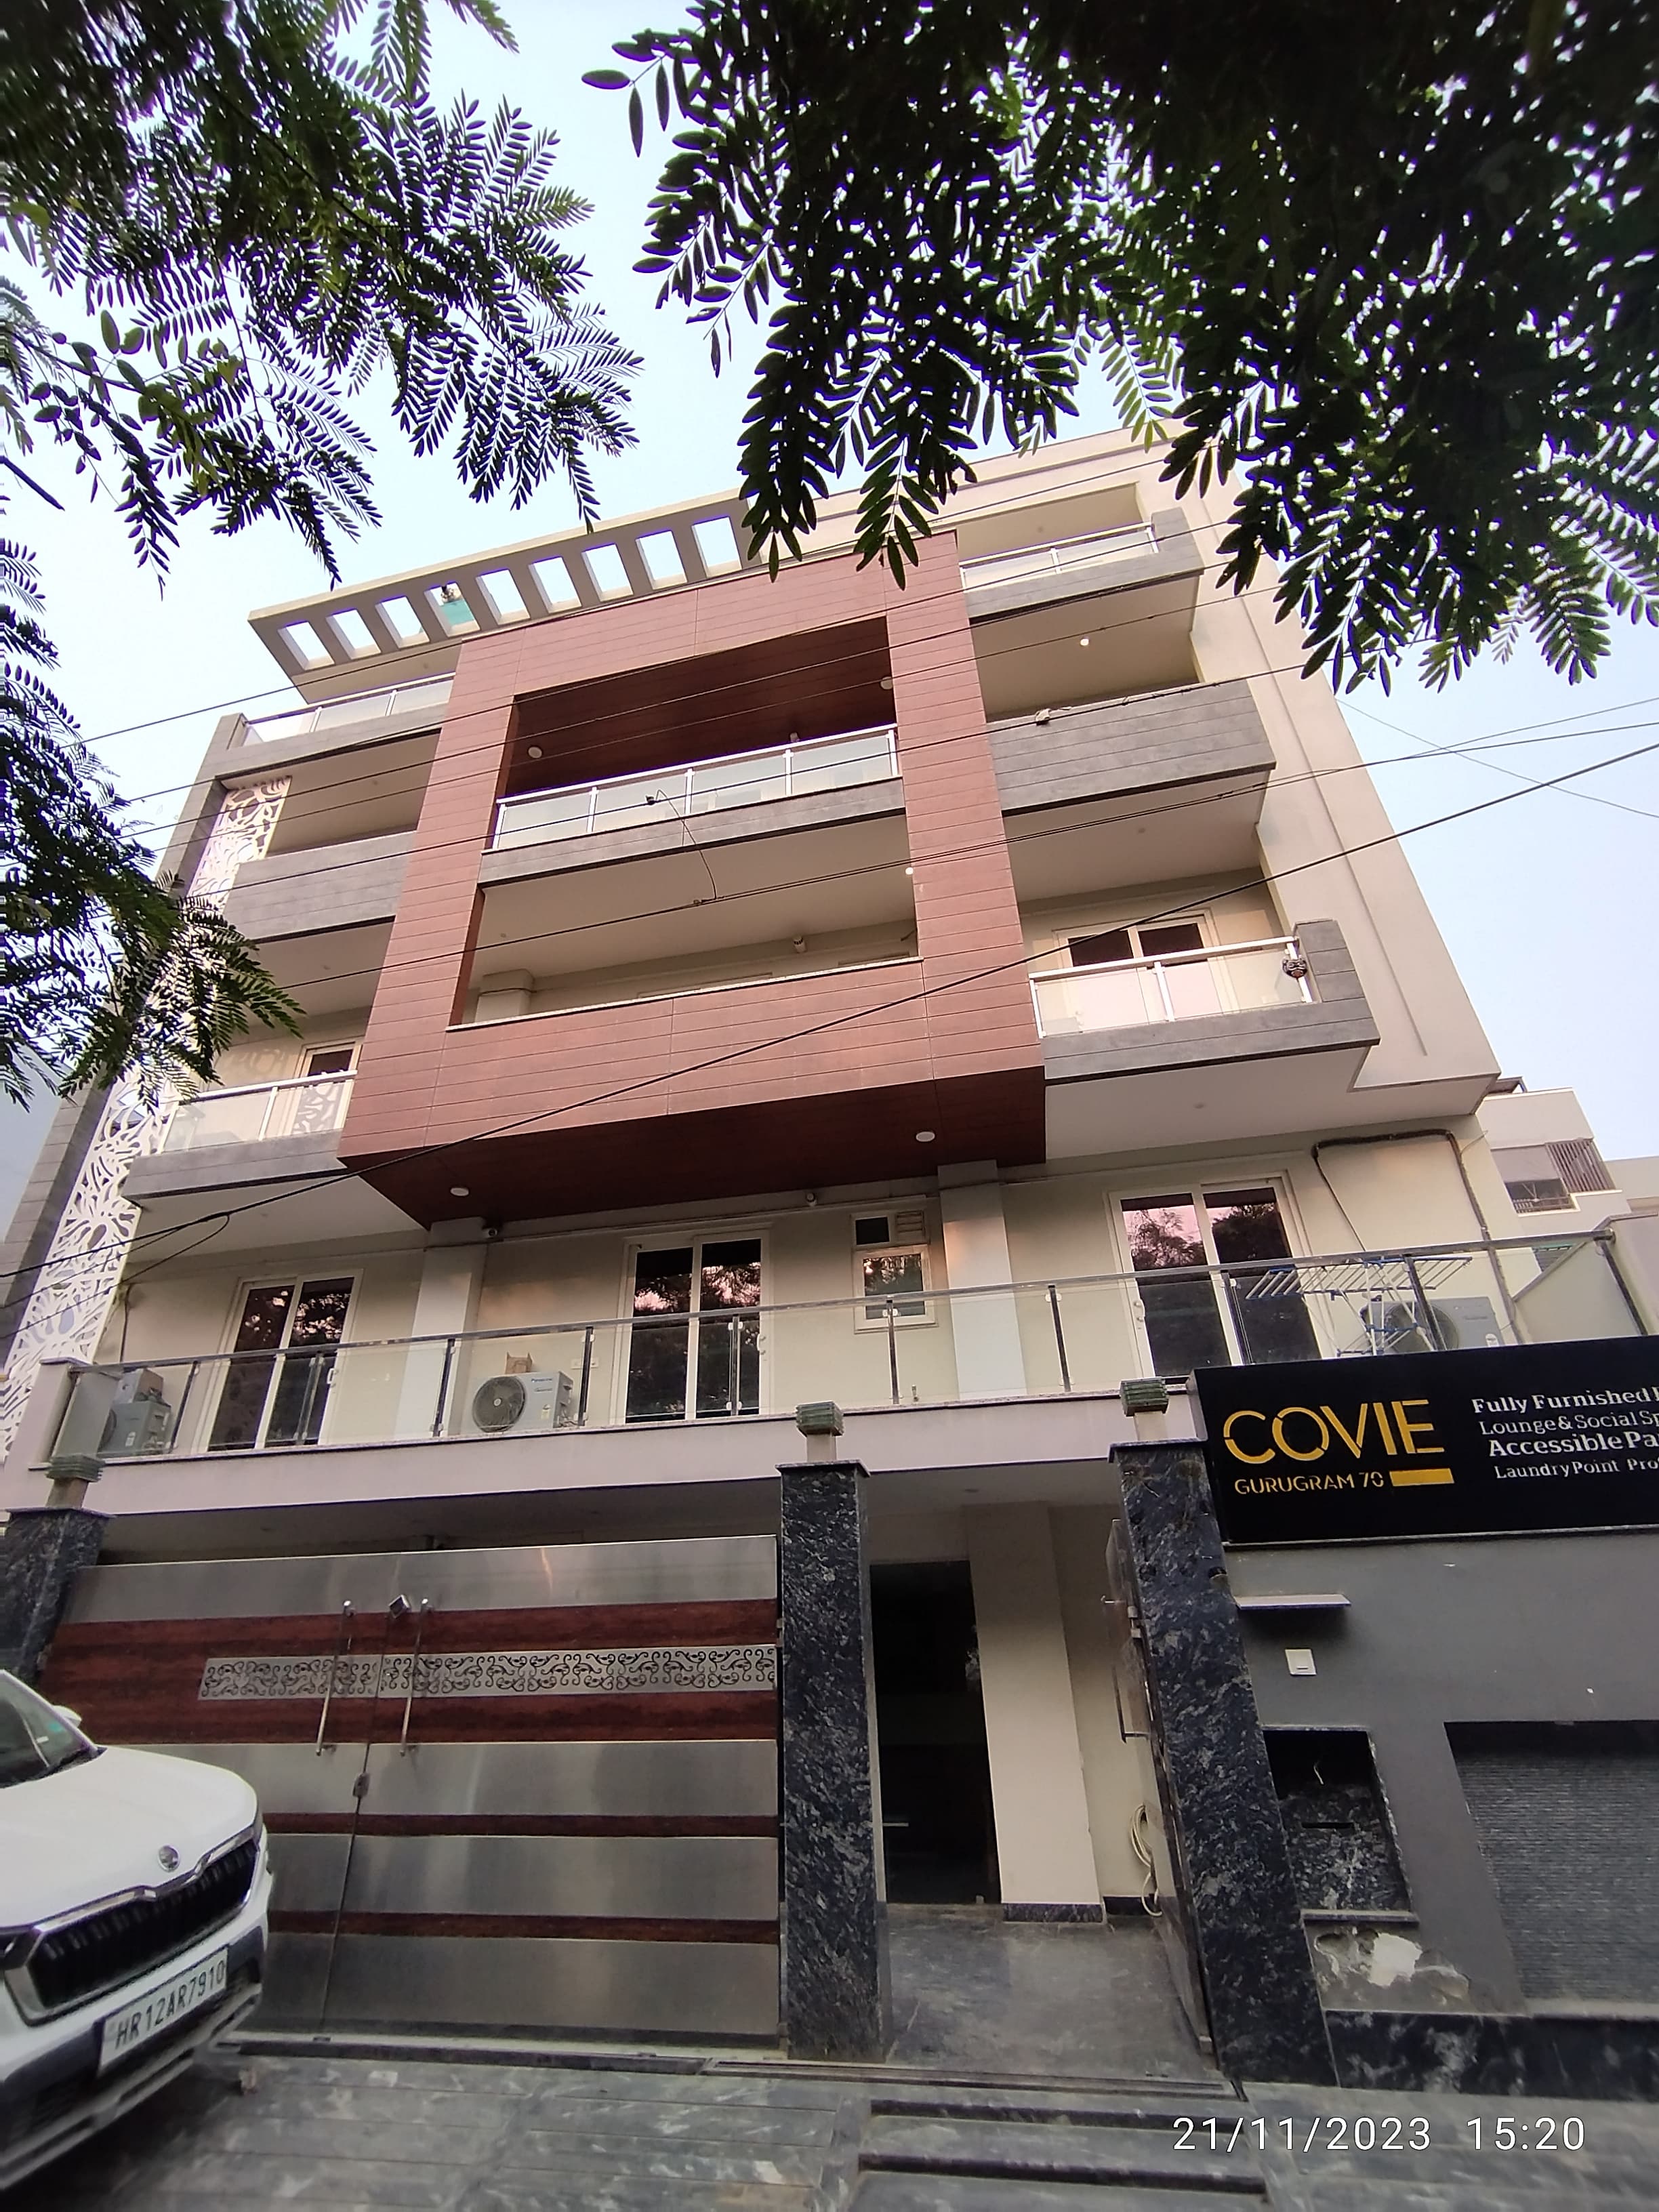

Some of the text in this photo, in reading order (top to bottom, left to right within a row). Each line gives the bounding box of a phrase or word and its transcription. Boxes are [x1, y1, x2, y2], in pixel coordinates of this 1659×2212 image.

[1471, 1397, 1527, 1413] Fully
[1531, 1387, 1651, 1409] Furnished
[1223, 1399, 1445, 1464] COVIE
[1574, 1412, 1638, 1429] Social
[1489, 1431, 1659, 1456] Accessible Pa
[1494, 1457, 1659, 1479] Laundry Point Pro
[1235, 1471, 1384, 1495] GURUGRAM 70
[115, 1960, 225, 2049] HR12AR7910
